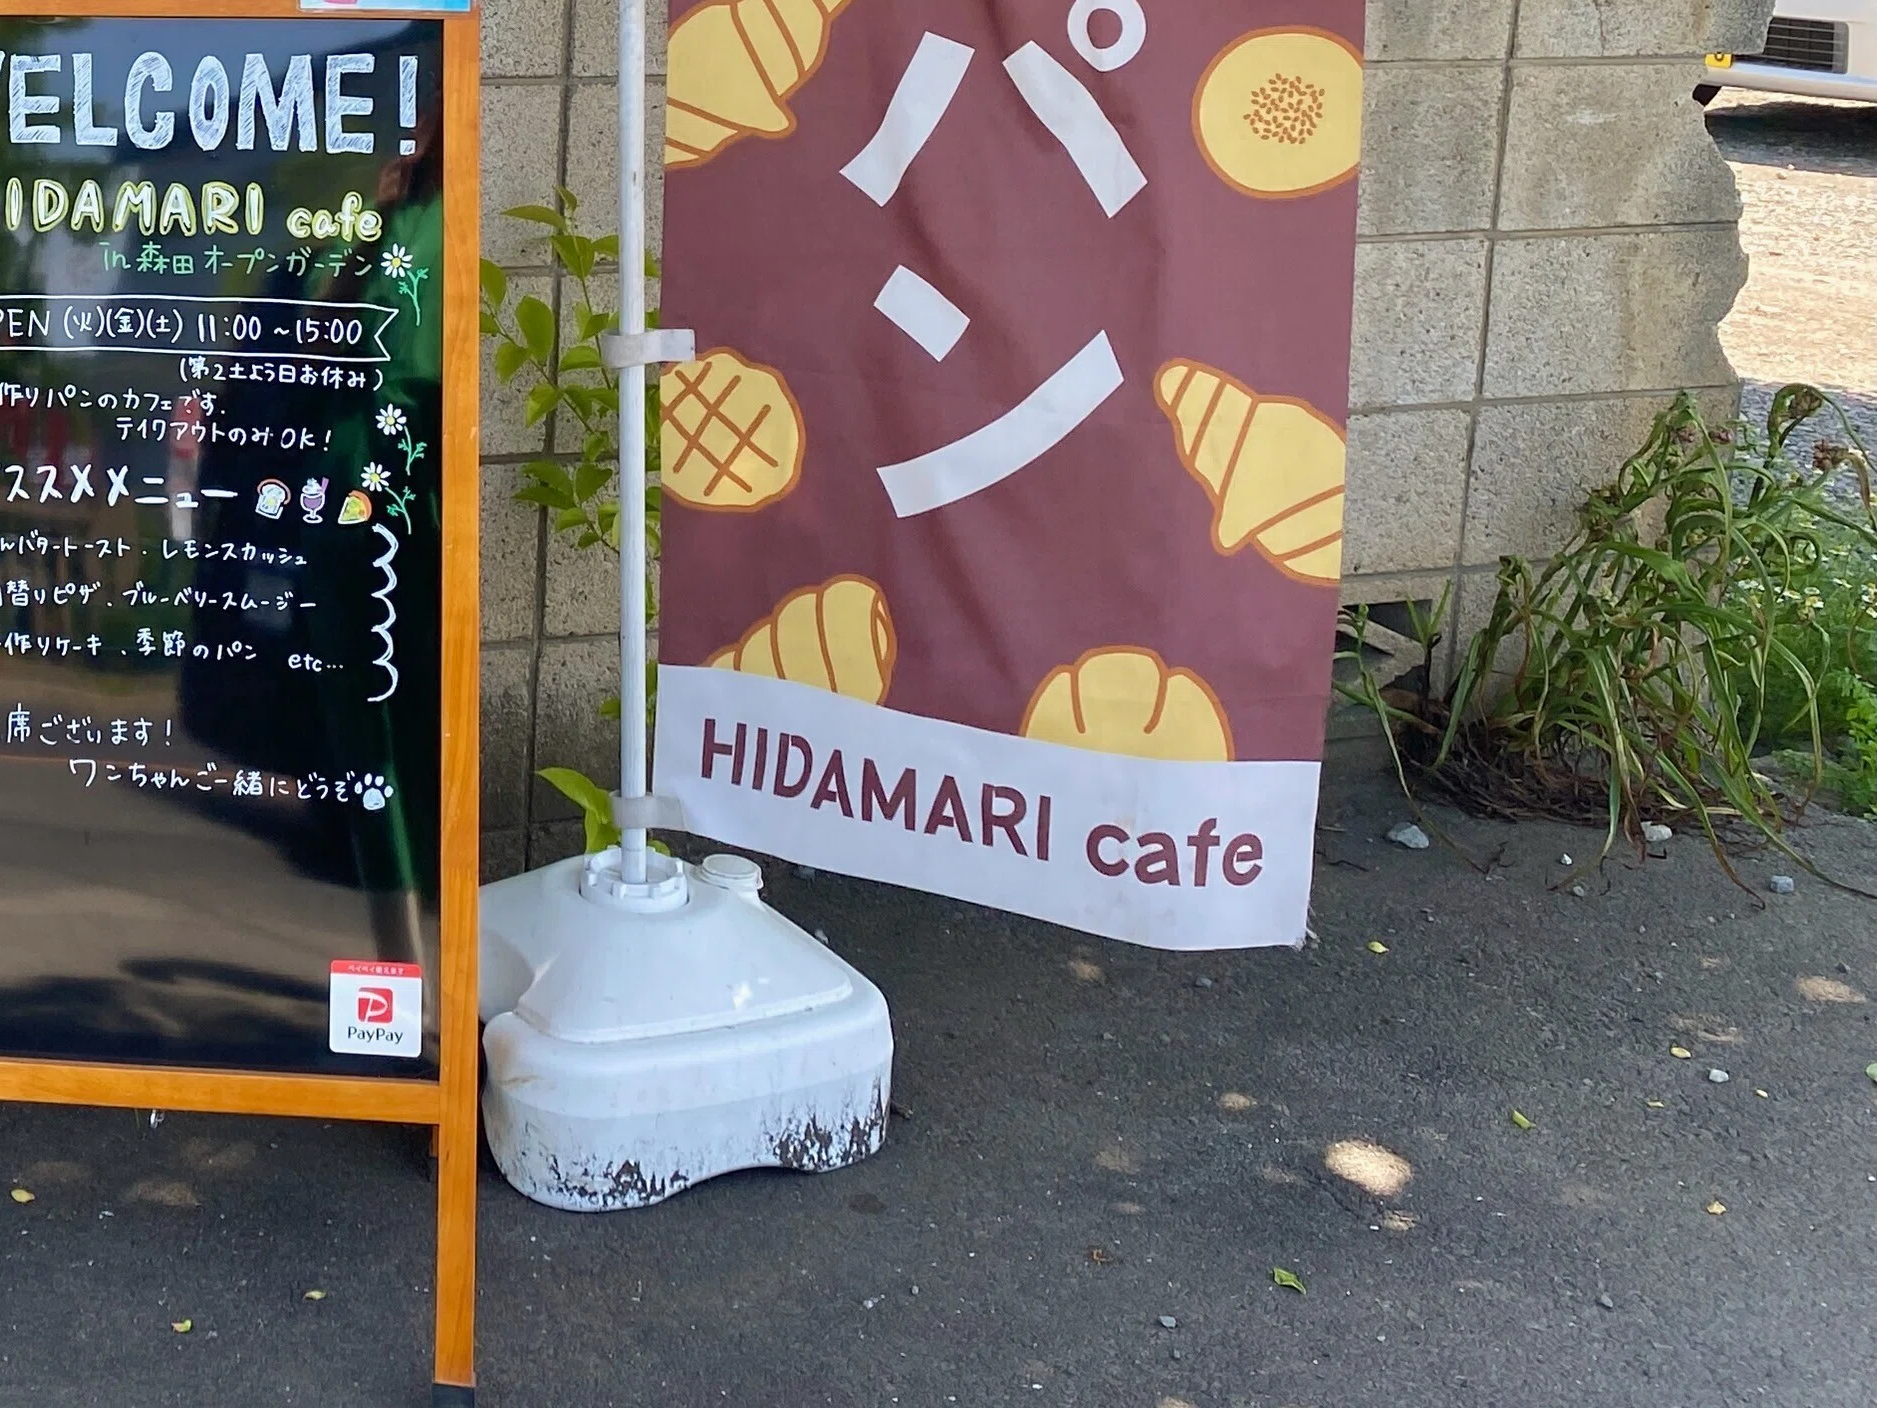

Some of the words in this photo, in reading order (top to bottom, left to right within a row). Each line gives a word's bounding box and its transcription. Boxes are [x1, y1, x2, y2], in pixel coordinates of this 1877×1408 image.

[286, 191, 383, 241] cafe
[99, 242, 131, 271] in
[197, 313, 262, 342] 11:00
[69, 756, 354, 802] ワンちゃんご一緒にどうぞ
[701, 718, 1051, 862] HIDAMARI
[1086, 817, 1264, 887] cafe
[347, 1026, 404, 1045] PayPay
